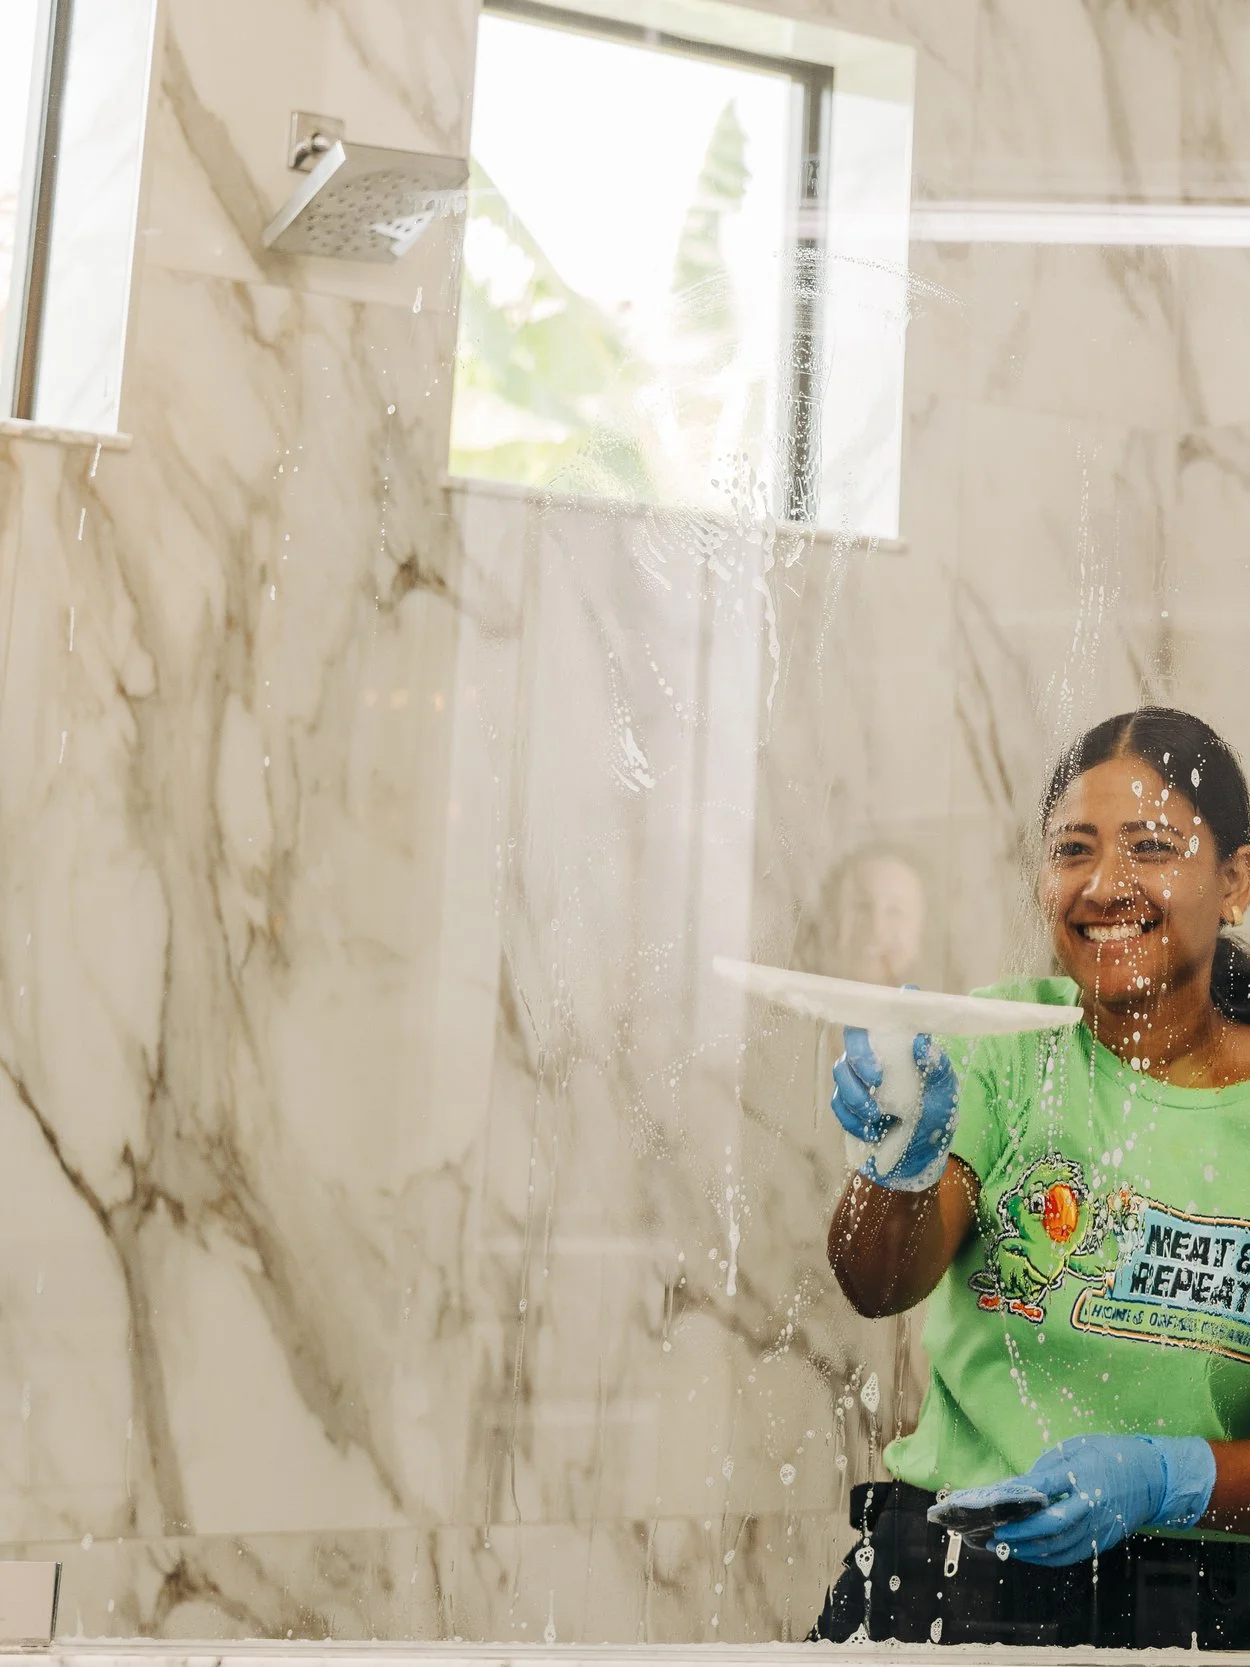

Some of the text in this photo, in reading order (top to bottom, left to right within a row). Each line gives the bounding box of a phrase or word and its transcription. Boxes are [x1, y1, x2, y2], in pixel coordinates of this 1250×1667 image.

[1145, 1224, 1235, 1268] NEAT
[1091, 1303, 1132, 1324] HOME
[1149, 1311, 1198, 1333] OFF
